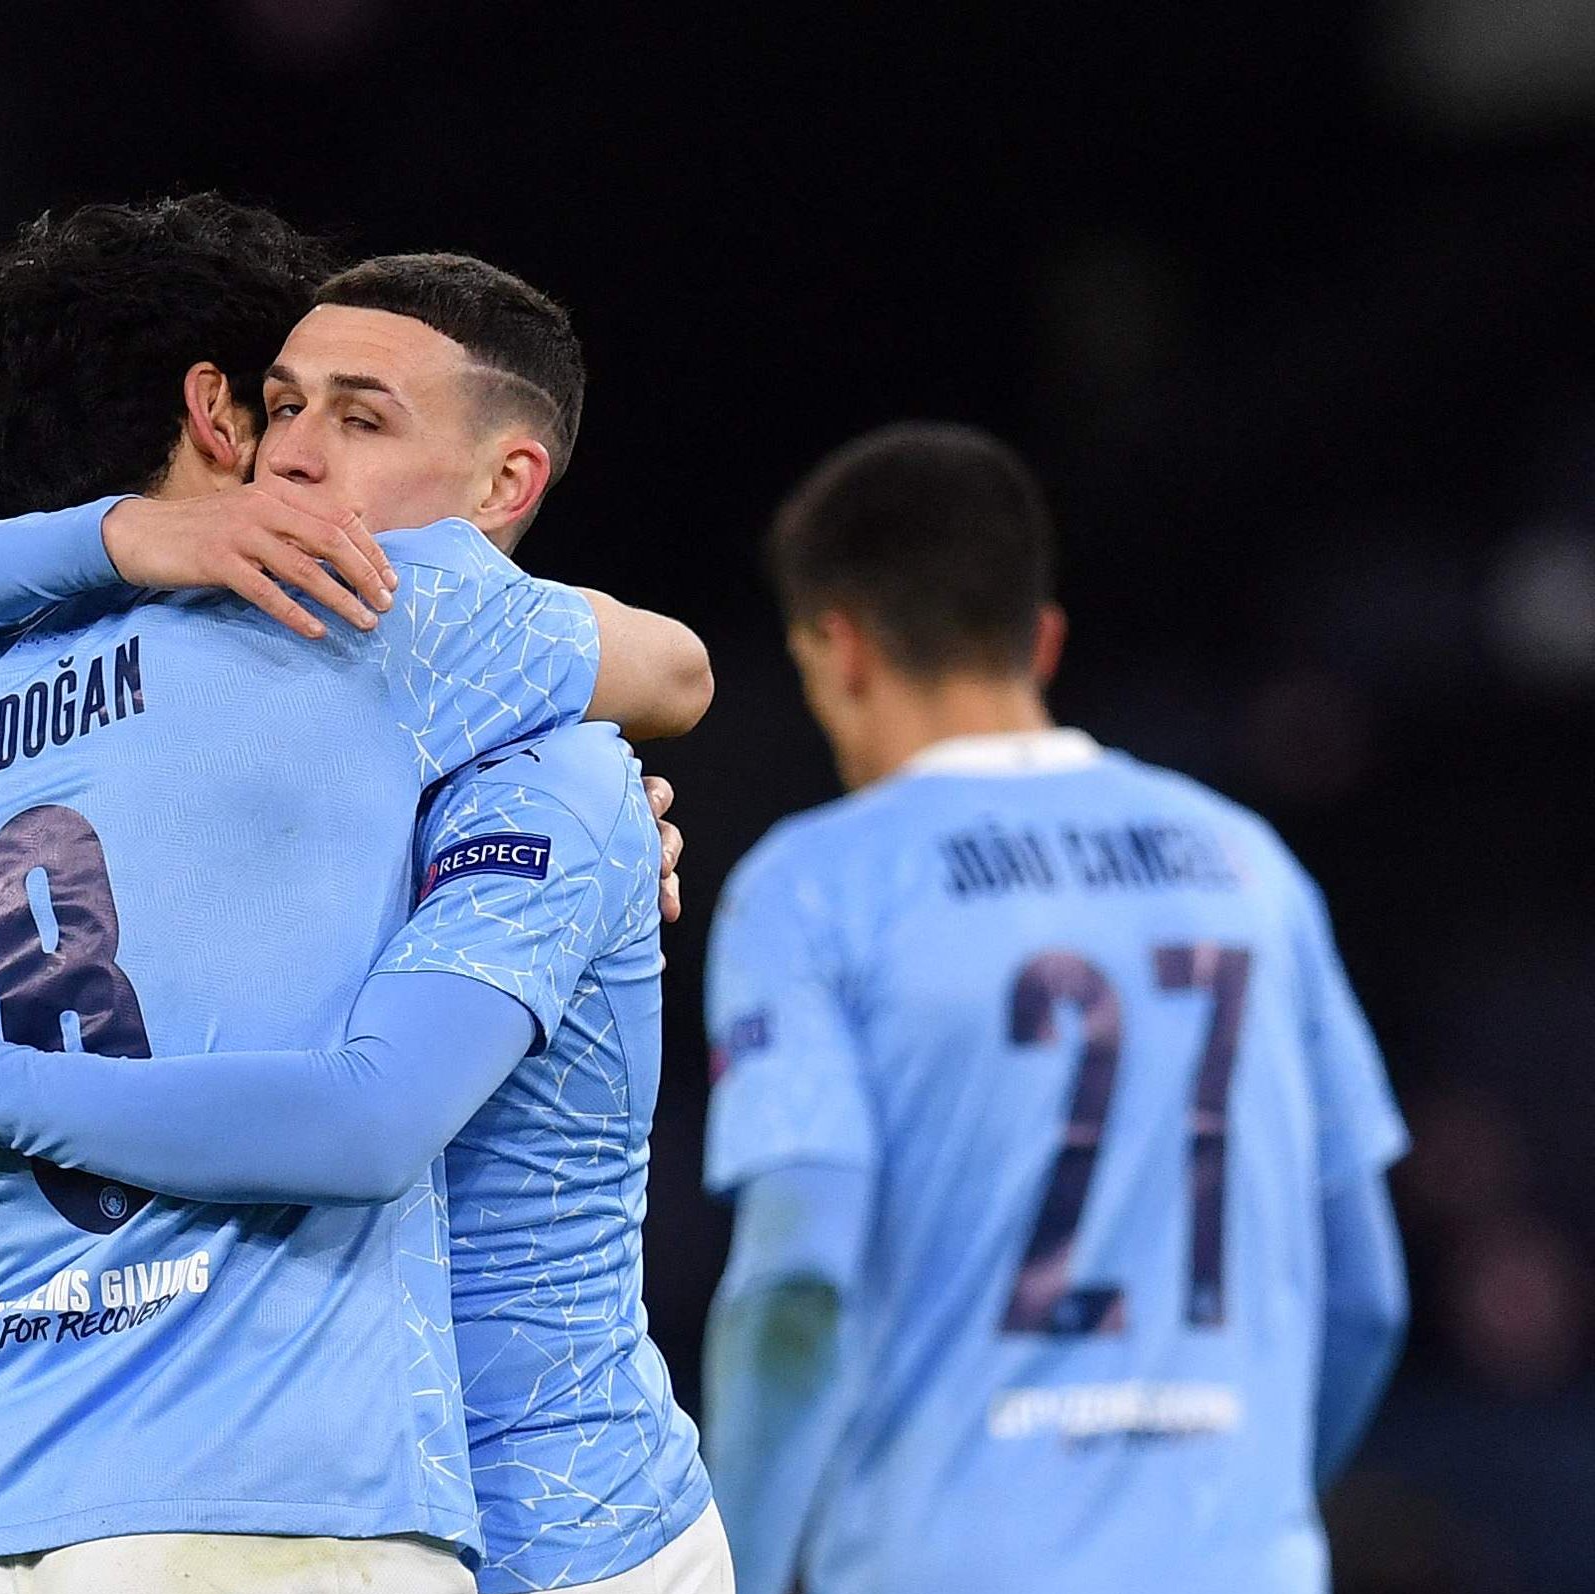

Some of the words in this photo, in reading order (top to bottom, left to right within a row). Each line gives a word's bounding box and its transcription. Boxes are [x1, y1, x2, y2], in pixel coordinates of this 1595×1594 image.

[439, 844, 547, 876] RESPECT
[1000, 942, 1252, 1335] 27
[0, 1313, 51, 1349] FOR
